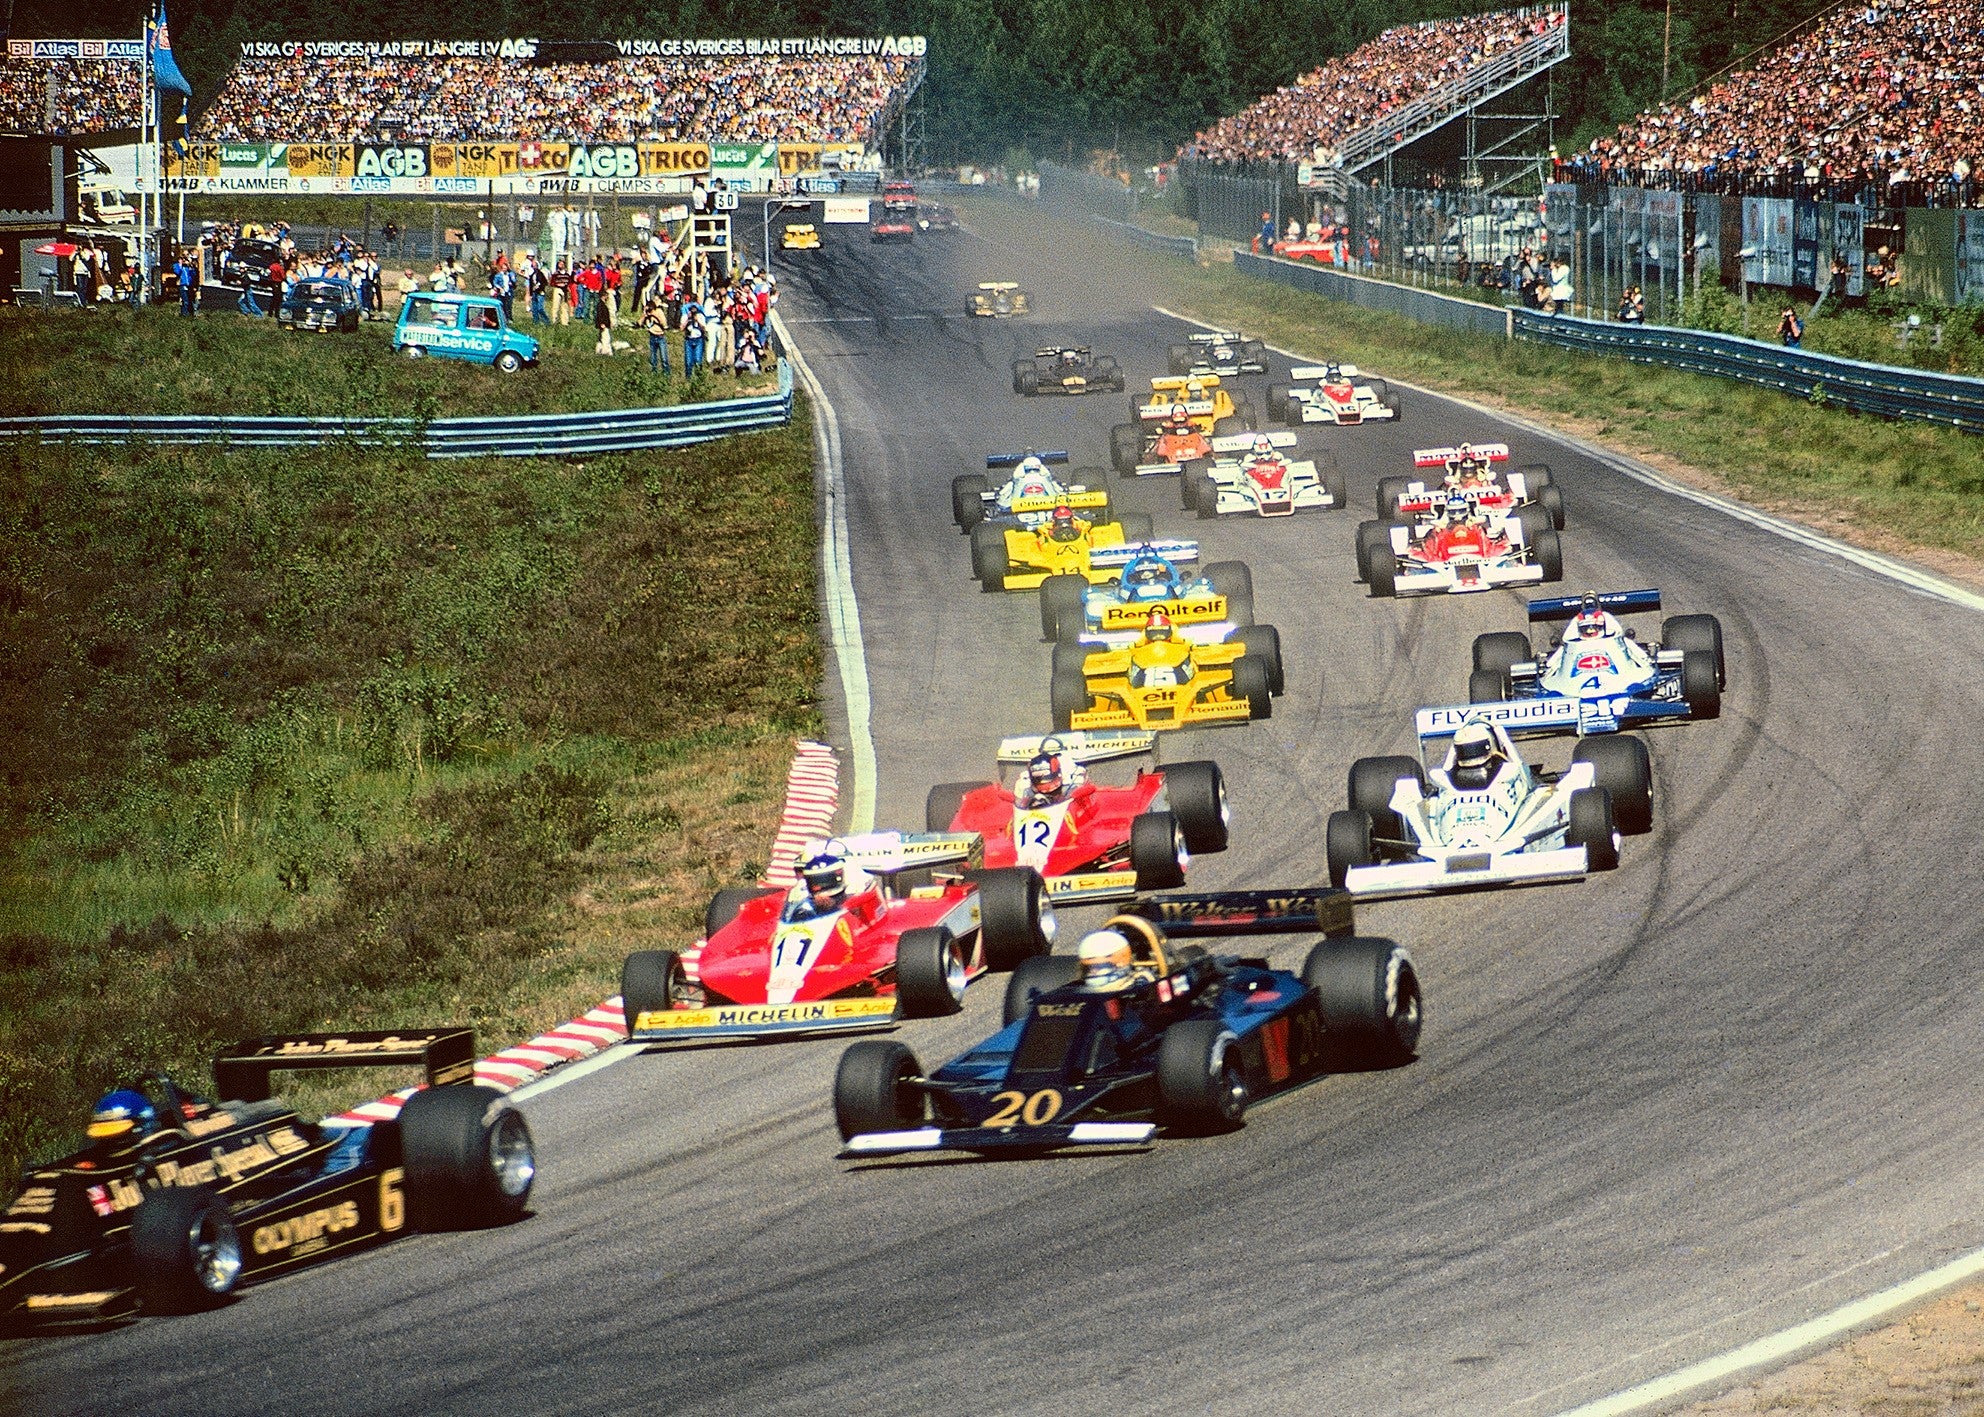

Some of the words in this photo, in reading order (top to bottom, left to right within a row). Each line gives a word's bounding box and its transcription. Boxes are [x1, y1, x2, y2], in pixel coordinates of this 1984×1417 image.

[11, 42, 31, 56] Bil
[36, 42, 78, 56] Atlas
[84, 42, 104, 56] Bil
[241, 42, 254, 56] VI
[255, 41, 281, 56] SKA
[304, 41, 364, 57] SVERIGES
[617, 39, 632, 55] VI
[633, 39, 660, 55] SKA
[660, 39, 681, 56] GE
[682, 39, 745, 56] SVERIGES
[746, 39, 780, 55] BILAR
[781, 38, 805, 55] ETT
[881, 35, 927, 57] AGB
[222, 147, 258, 162] Lucas
[310, 146, 351, 161] NGK
[455, 146, 496, 161] NGK
[641, 150, 709, 170] TRICO
[711, 146, 748, 163] Lucas
[357, 147, 427, 177] AGB
[569, 146, 639, 177] AGB
[352, 178, 391, 191] Atlas
[435, 178, 476, 191] Atlas
[598, 180, 652, 192] CLAMPS
[442, 336, 492, 351] service
[1193, 600, 1222, 614] elf
[1580, 676, 1601, 689] 4
[1143, 691, 1178, 702] elf
[1431, 709, 1471, 726] FLY
[1018, 820, 1051, 848] 12
[718, 1005, 825, 1025] MICHELIN
[980, 1088, 1064, 1129] 20
[379, 1166, 406, 1233] 6
[252, 1200, 360, 1255] OLYMPUS
